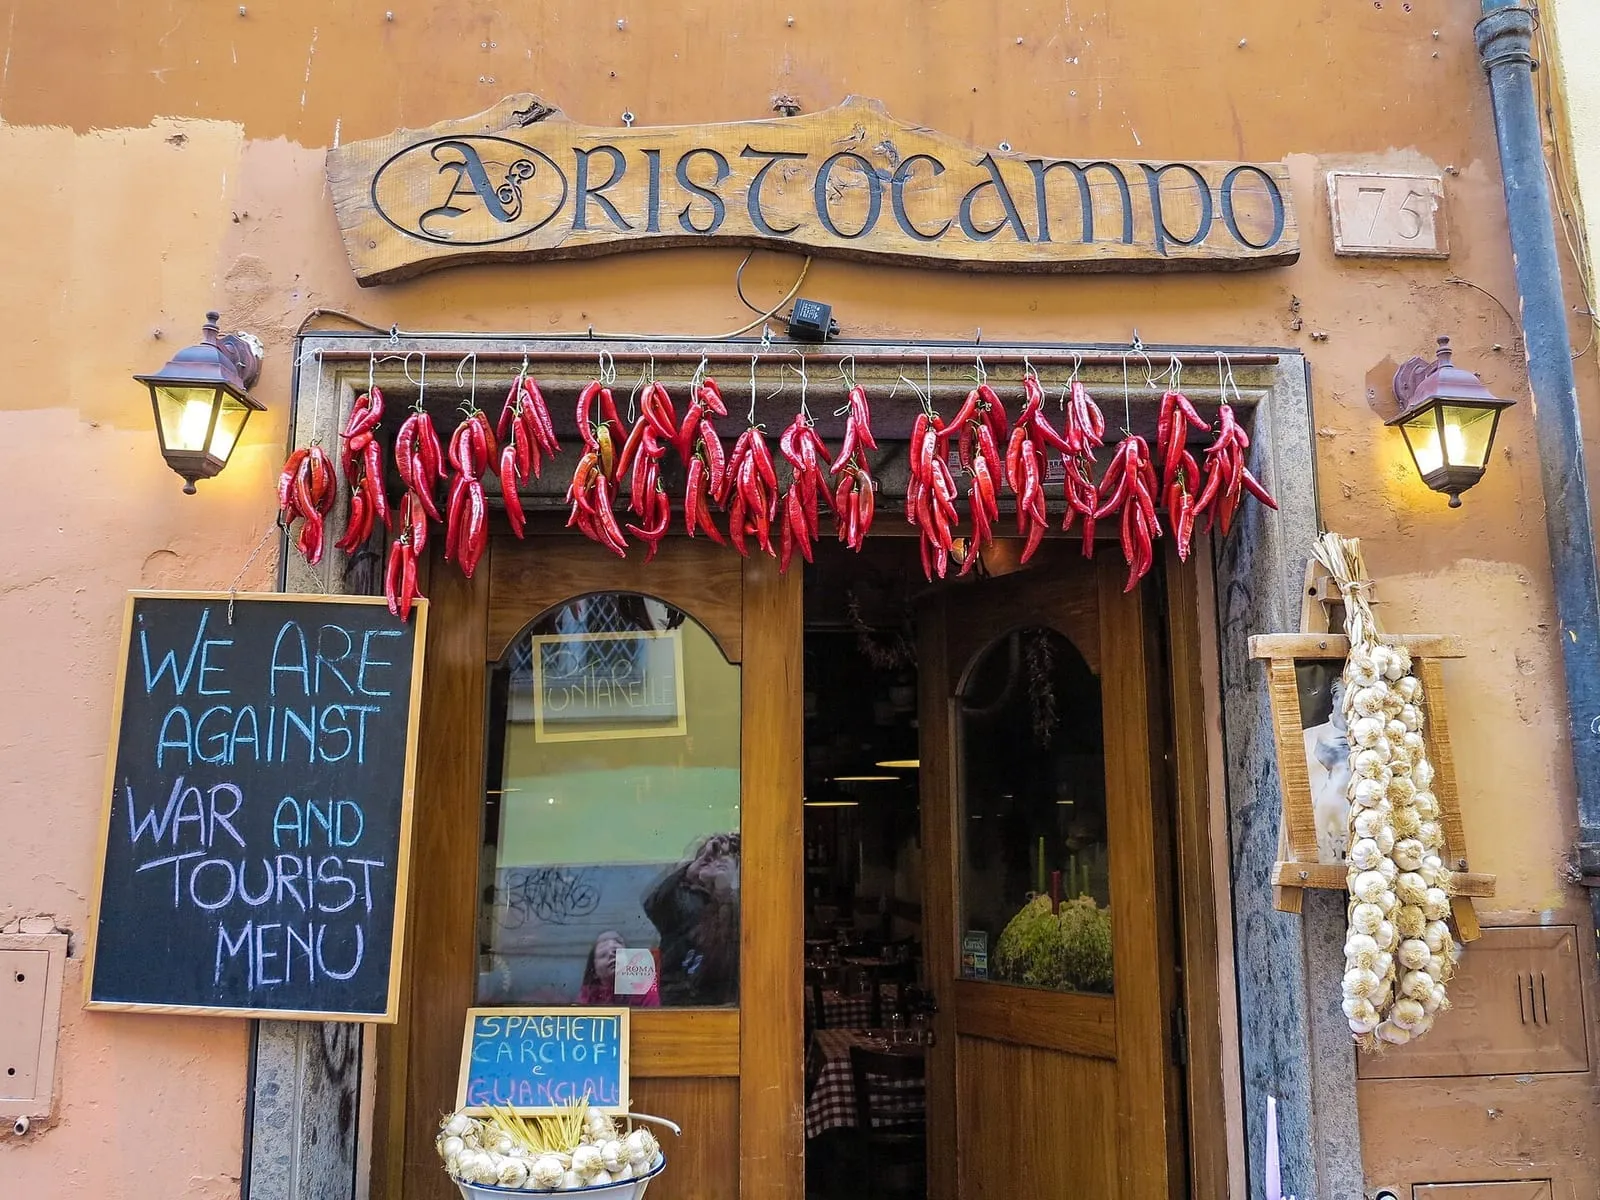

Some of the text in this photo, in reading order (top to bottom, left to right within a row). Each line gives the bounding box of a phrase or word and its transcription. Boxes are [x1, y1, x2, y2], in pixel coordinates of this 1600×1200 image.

[1357, 187, 1425, 241] 75
[138, 608, 402, 696] WE ARE
[157, 704, 381, 768] AGAINST
[126, 776, 364, 848] WAR AND
[135, 850, 385, 914] TOURIST
[214, 920, 364, 991] MENU
[476, 1016, 618, 1042] SPAGHETTI
